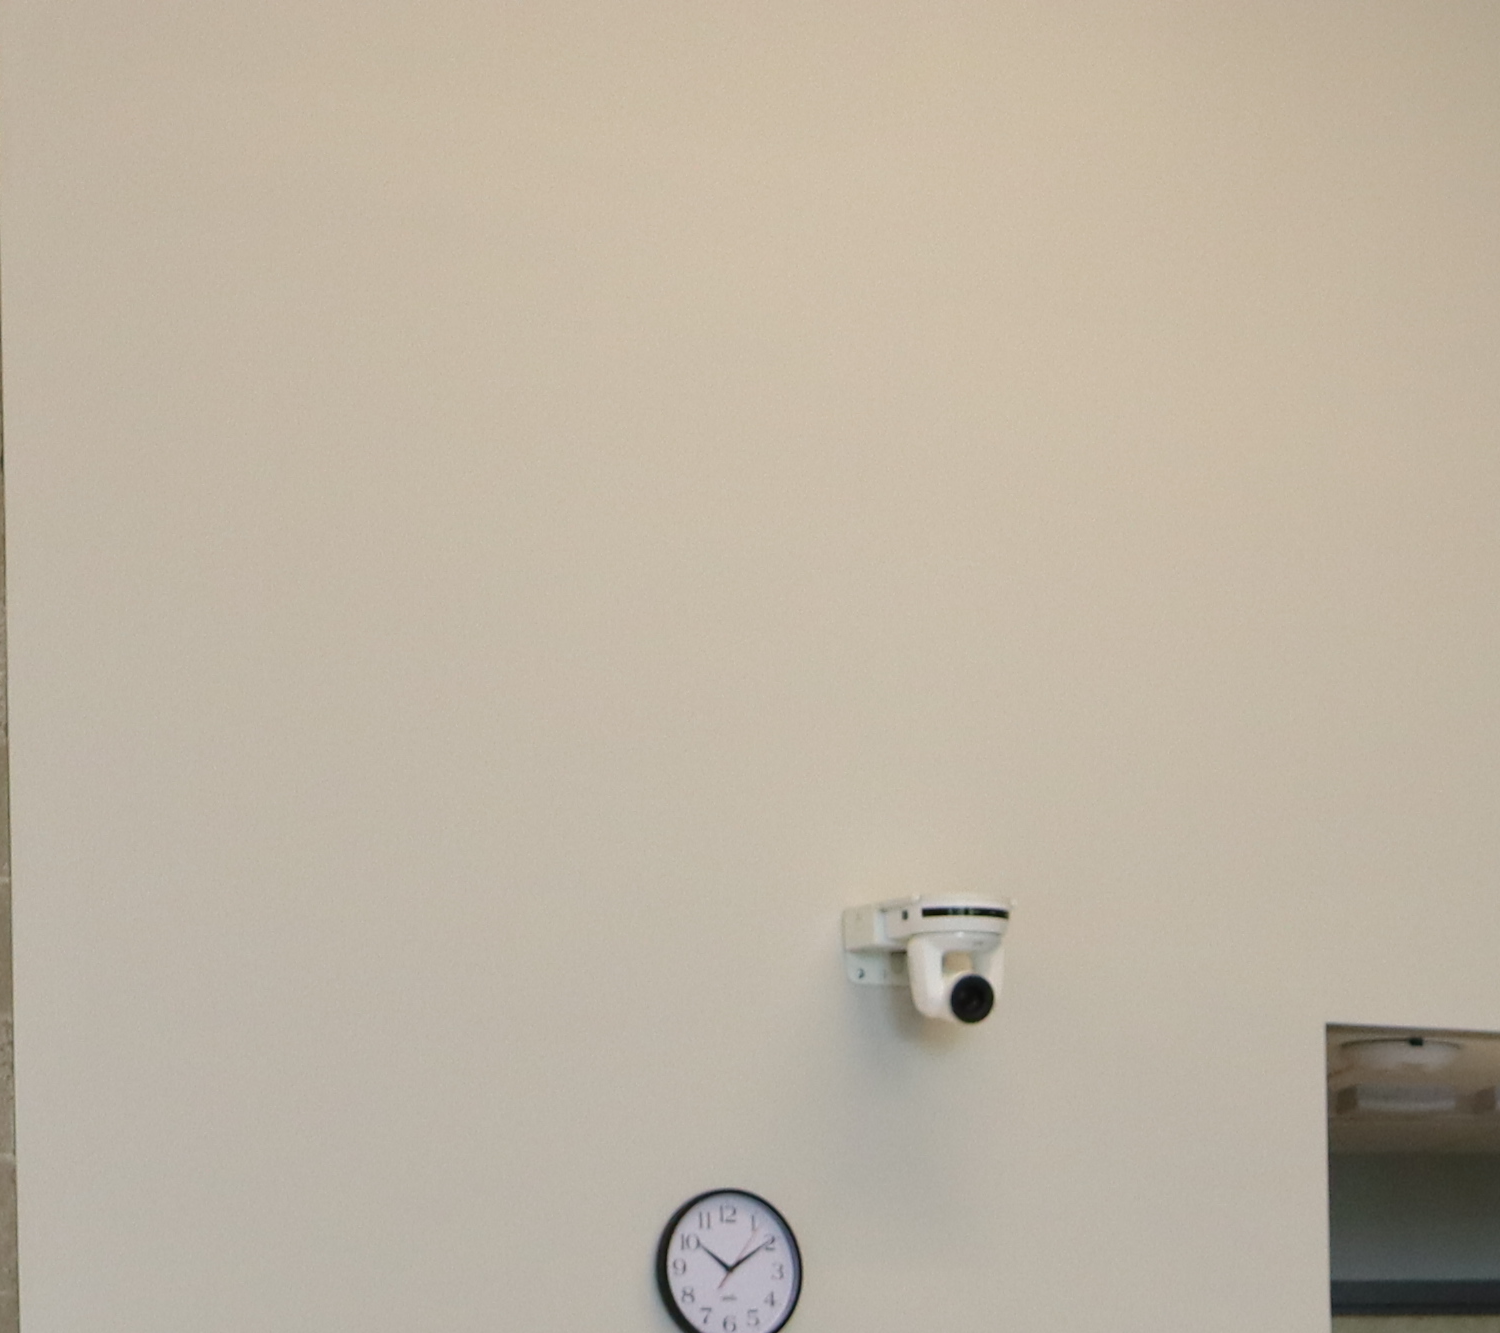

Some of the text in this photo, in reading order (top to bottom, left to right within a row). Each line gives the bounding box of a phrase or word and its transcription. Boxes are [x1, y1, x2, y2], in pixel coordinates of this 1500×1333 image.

[699, 1211, 711, 1229] 11
[720, 1205, 737, 1223] 12
[681, 1233, 700, 1250] 10
[764, 1235, 776, 1251] 2
[673, 1258, 687, 1275] 9
[771, 1262, 784, 1280] 3
[681, 1286, 695, 1303] 8
[764, 1291, 776, 1307] 4
[700, 1307, 712, 1324] 7
[722, 1315, 737, 1333] 6
[747, 1309, 760, 1326] 5
